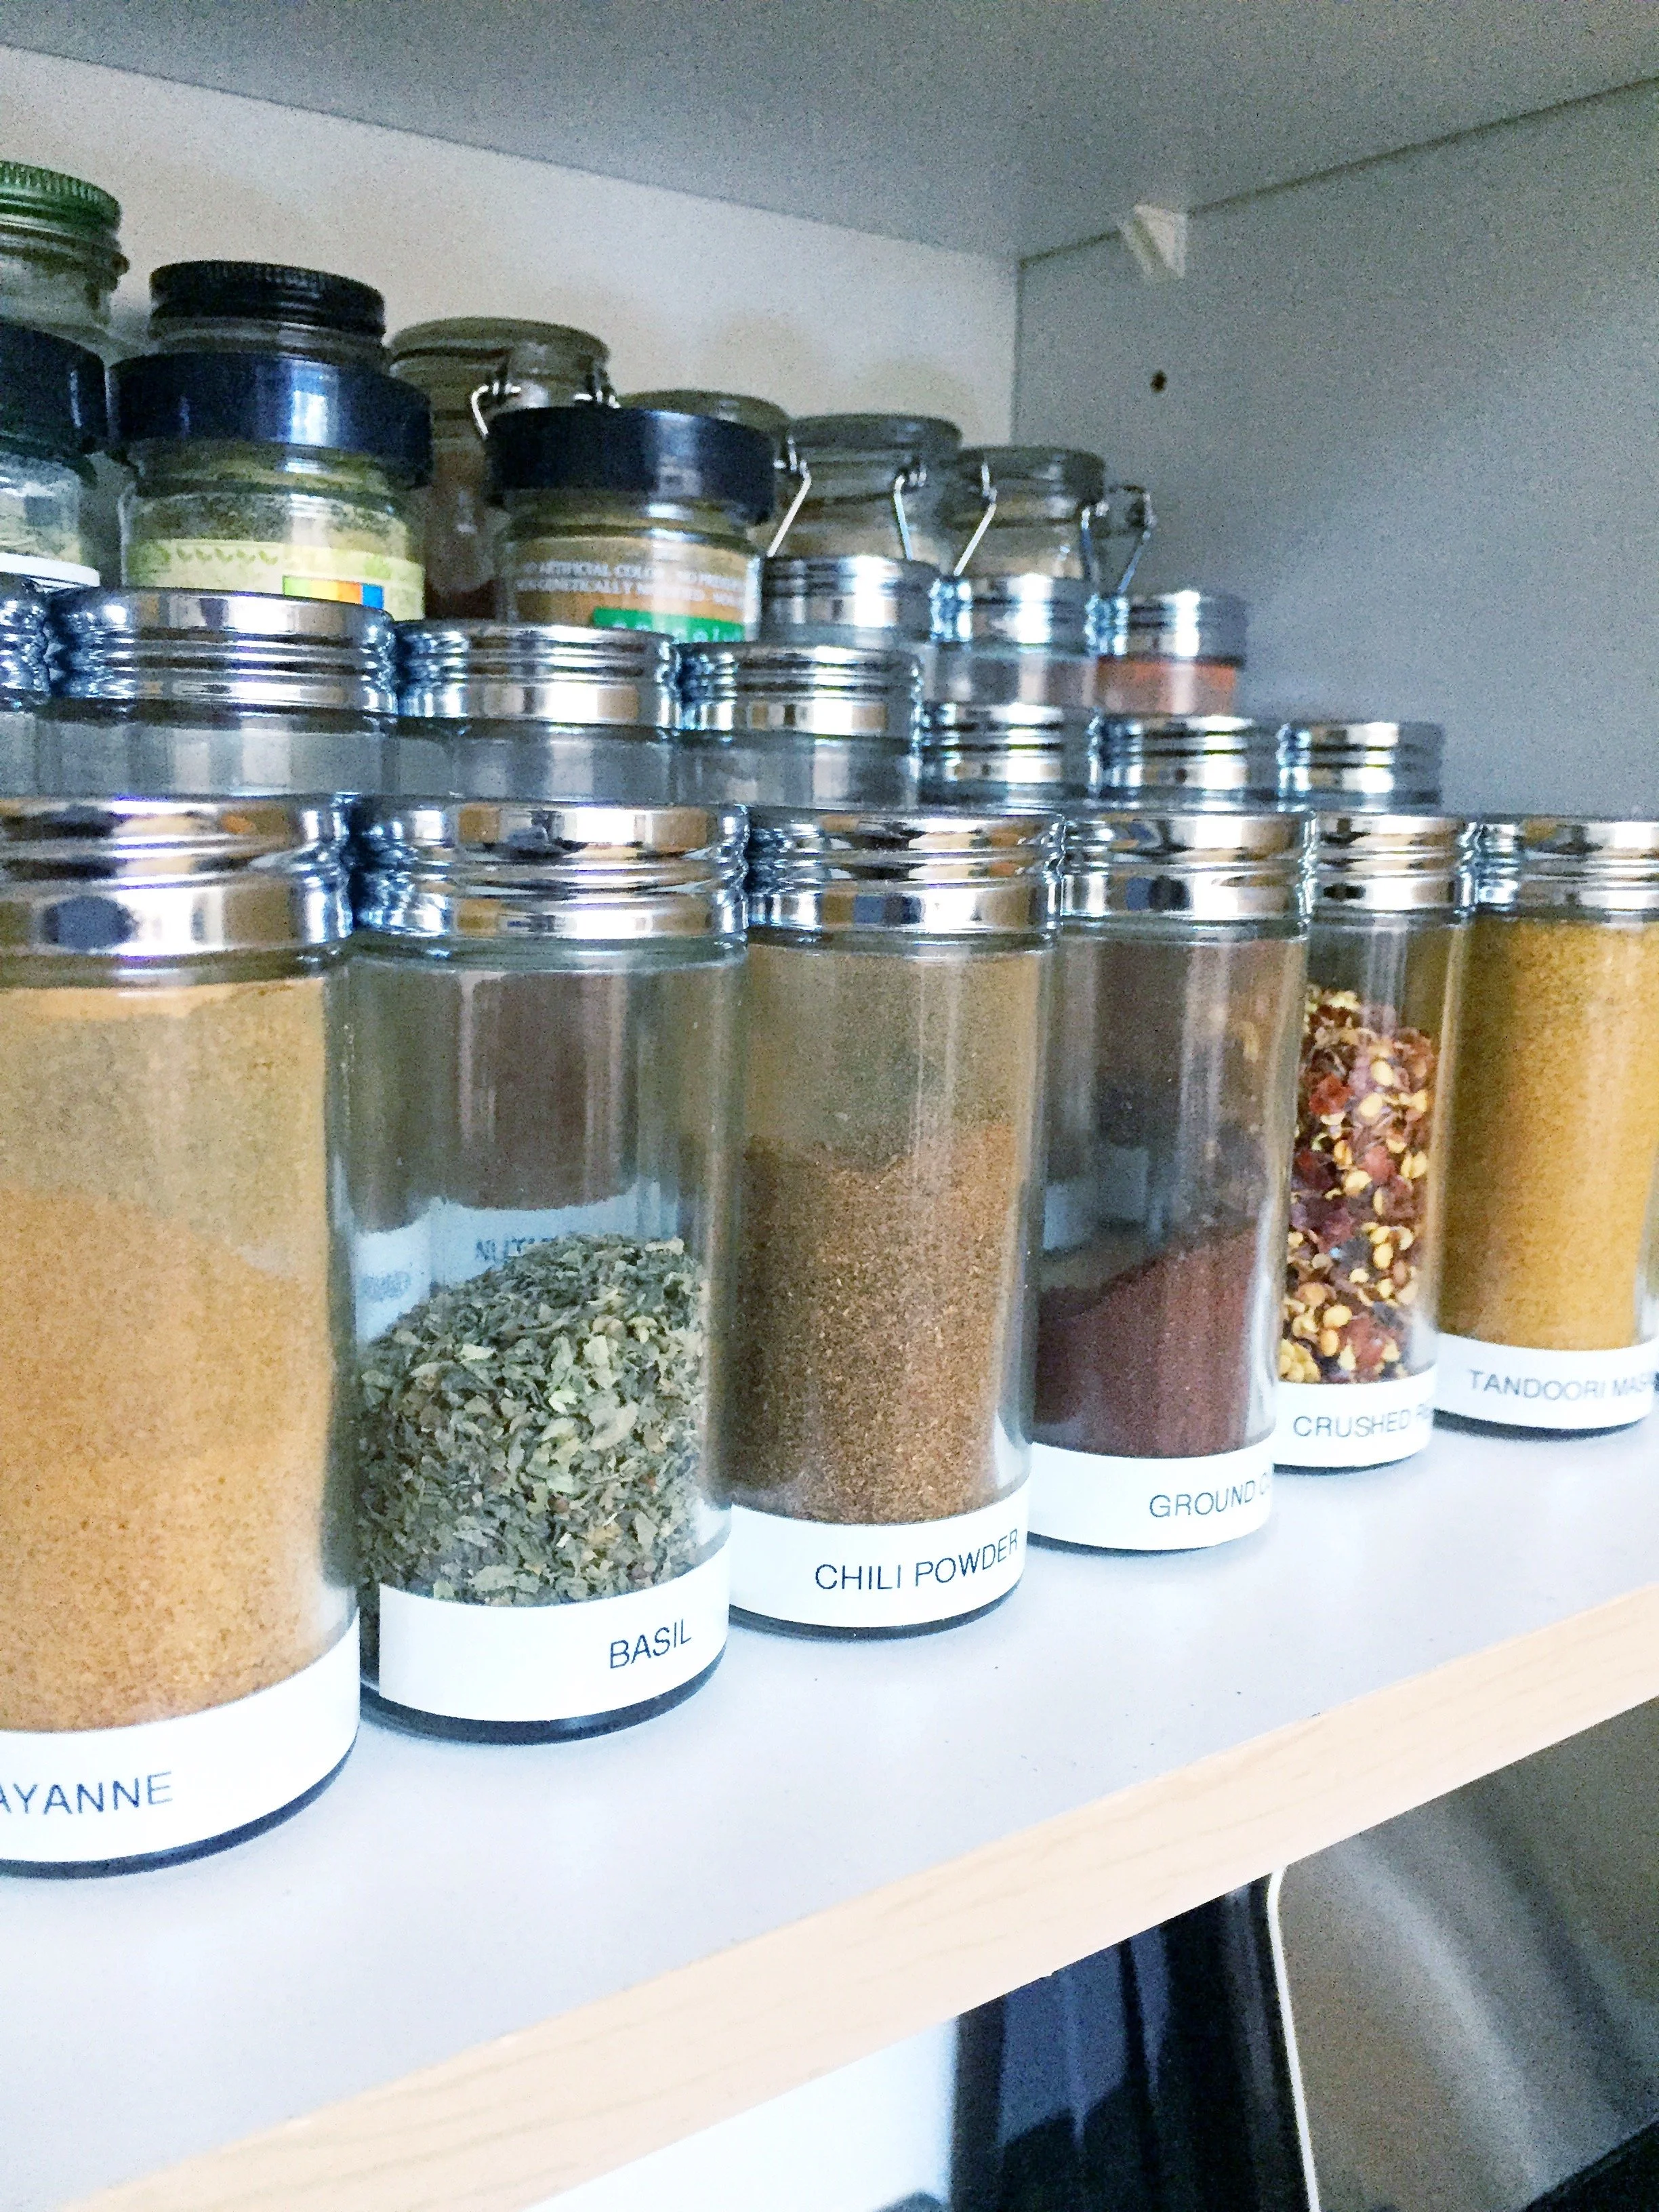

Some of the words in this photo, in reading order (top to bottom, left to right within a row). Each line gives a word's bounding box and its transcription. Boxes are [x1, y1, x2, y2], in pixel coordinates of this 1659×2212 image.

[1469, 1368, 1606, 1401] TANDOORI
[1292, 1408, 1411, 1438] CRUSHED
[1149, 1480, 1256, 1518] GROUND
[815, 1563, 901, 1590] CHILI
[916, 1528, 1018, 1587] POWDER
[610, 1618, 692, 1668] BASIL
